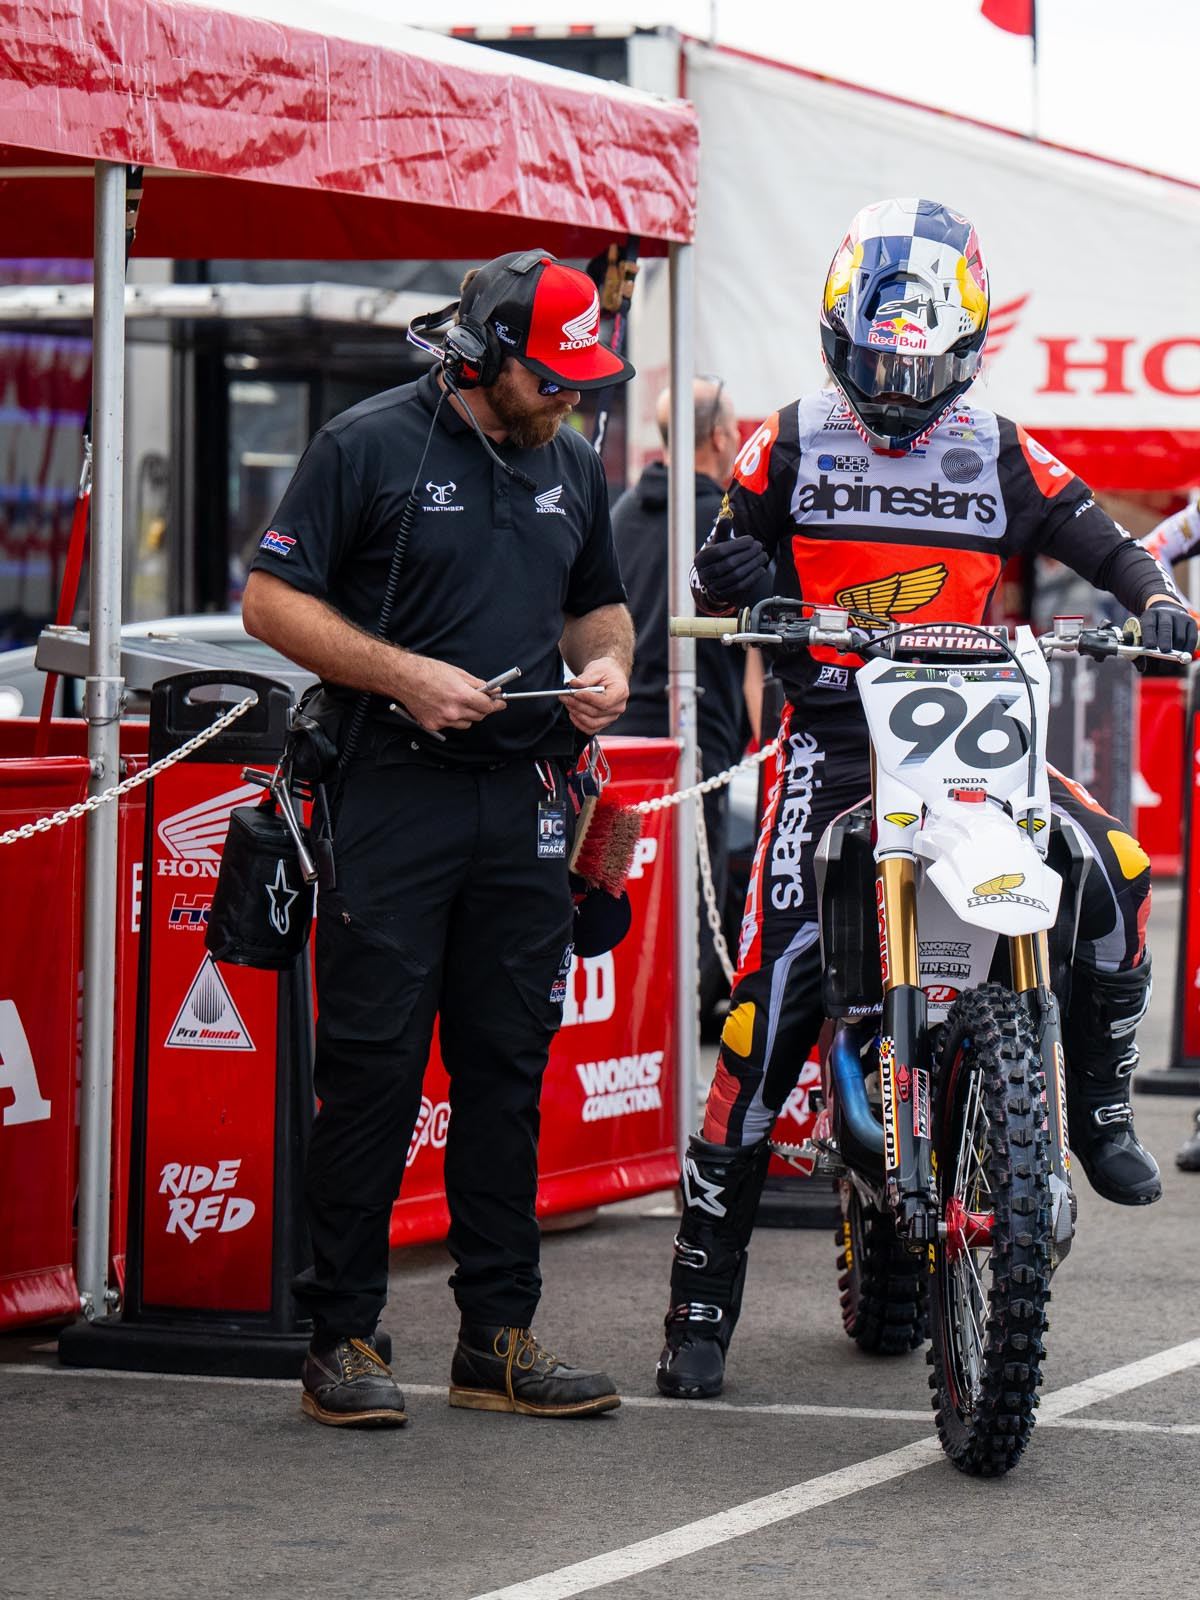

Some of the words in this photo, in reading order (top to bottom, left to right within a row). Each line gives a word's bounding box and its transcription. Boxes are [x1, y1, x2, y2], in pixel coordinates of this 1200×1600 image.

[868, 333, 897, 346] Red
[899, 336, 927, 350] Bull
[823, 423, 856, 431] SHOW
[835, 456, 867, 465] QUAD
[835, 464, 868, 473] LOCK
[799, 475, 997, 524] alpinestars
[422, 505, 464, 513] TRUETIMBER
[536, 507, 567, 517] HONDA
[899, 634, 1003, 650] RENTHAL
[938, 667, 988, 678] MONSTER
[889, 687, 1032, 769] 96
[943, 777, 989, 785] HONDA
[771, 732, 825, 910] alpinestars
[539, 845, 564, 854] TRACK
[157, 858, 221, 879] HON
[967, 893, 1050, 913] HONDA
[168, 923, 204, 931] Honda
[920, 942, 972, 951] WORKS
[848, 1005, 871, 1015] Twin
[176, 1027, 198, 1038] Pro
[199, 1028, 241, 1040] Honda
[576, 1050, 664, 1097] WORKS
[582, 1085, 662, 1123] CONNECTION
[882, 1061, 896, 1168] DUNLOP
[159, 1158, 242, 1199] RIDE
[166, 1194, 256, 1244] RED
